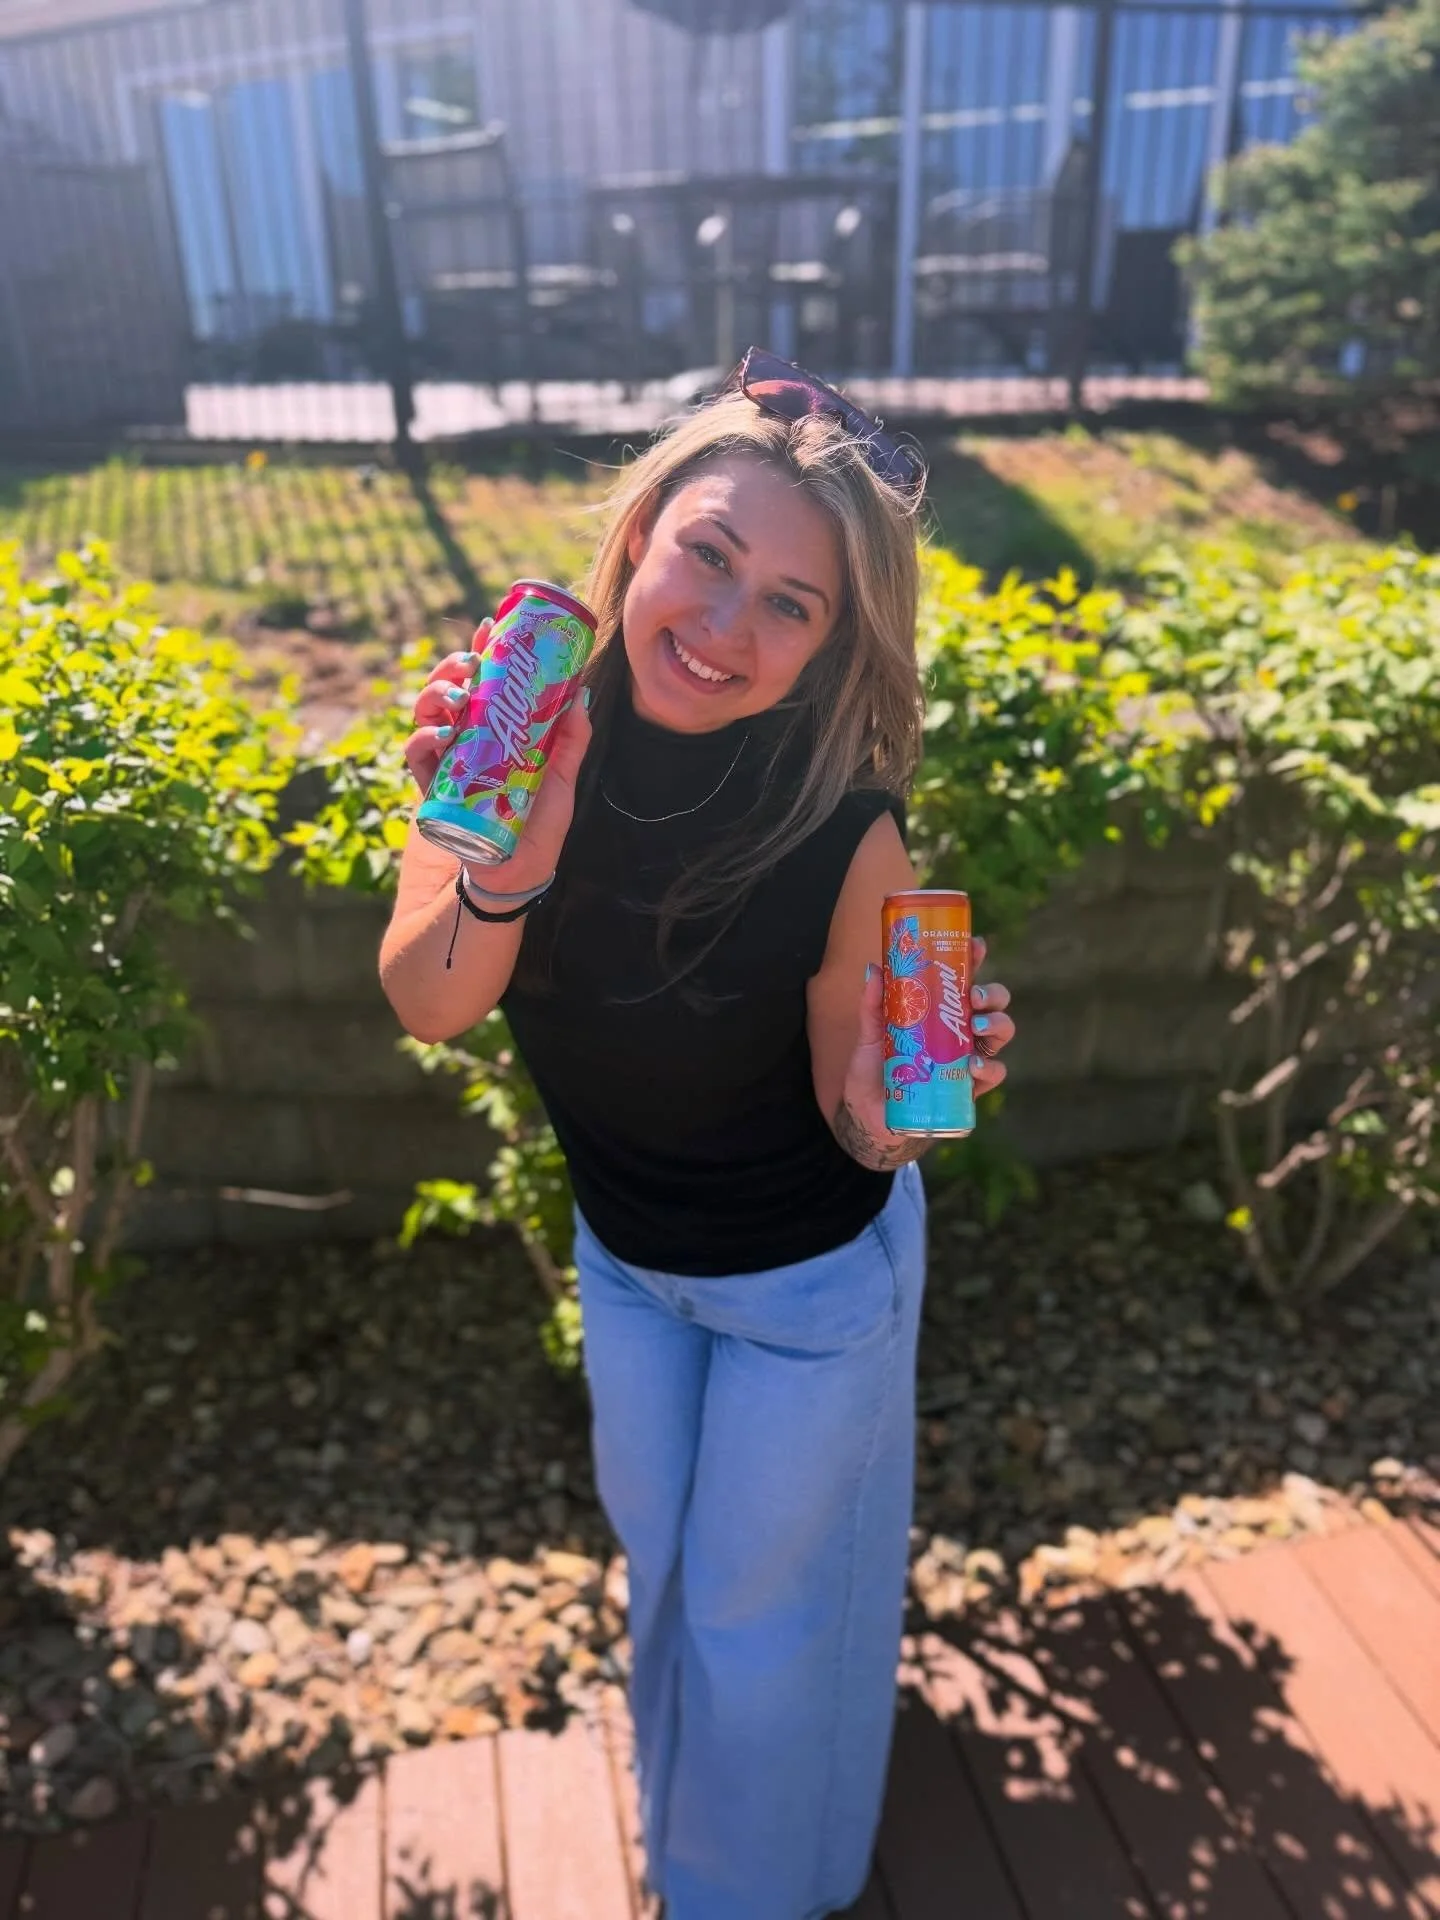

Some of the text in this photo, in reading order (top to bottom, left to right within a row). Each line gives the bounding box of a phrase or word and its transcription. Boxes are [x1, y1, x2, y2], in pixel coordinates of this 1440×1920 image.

[486, 635, 538, 768] Alani
[922, 930, 960, 938] ORANGE
[933, 960, 970, 1047] Alani
